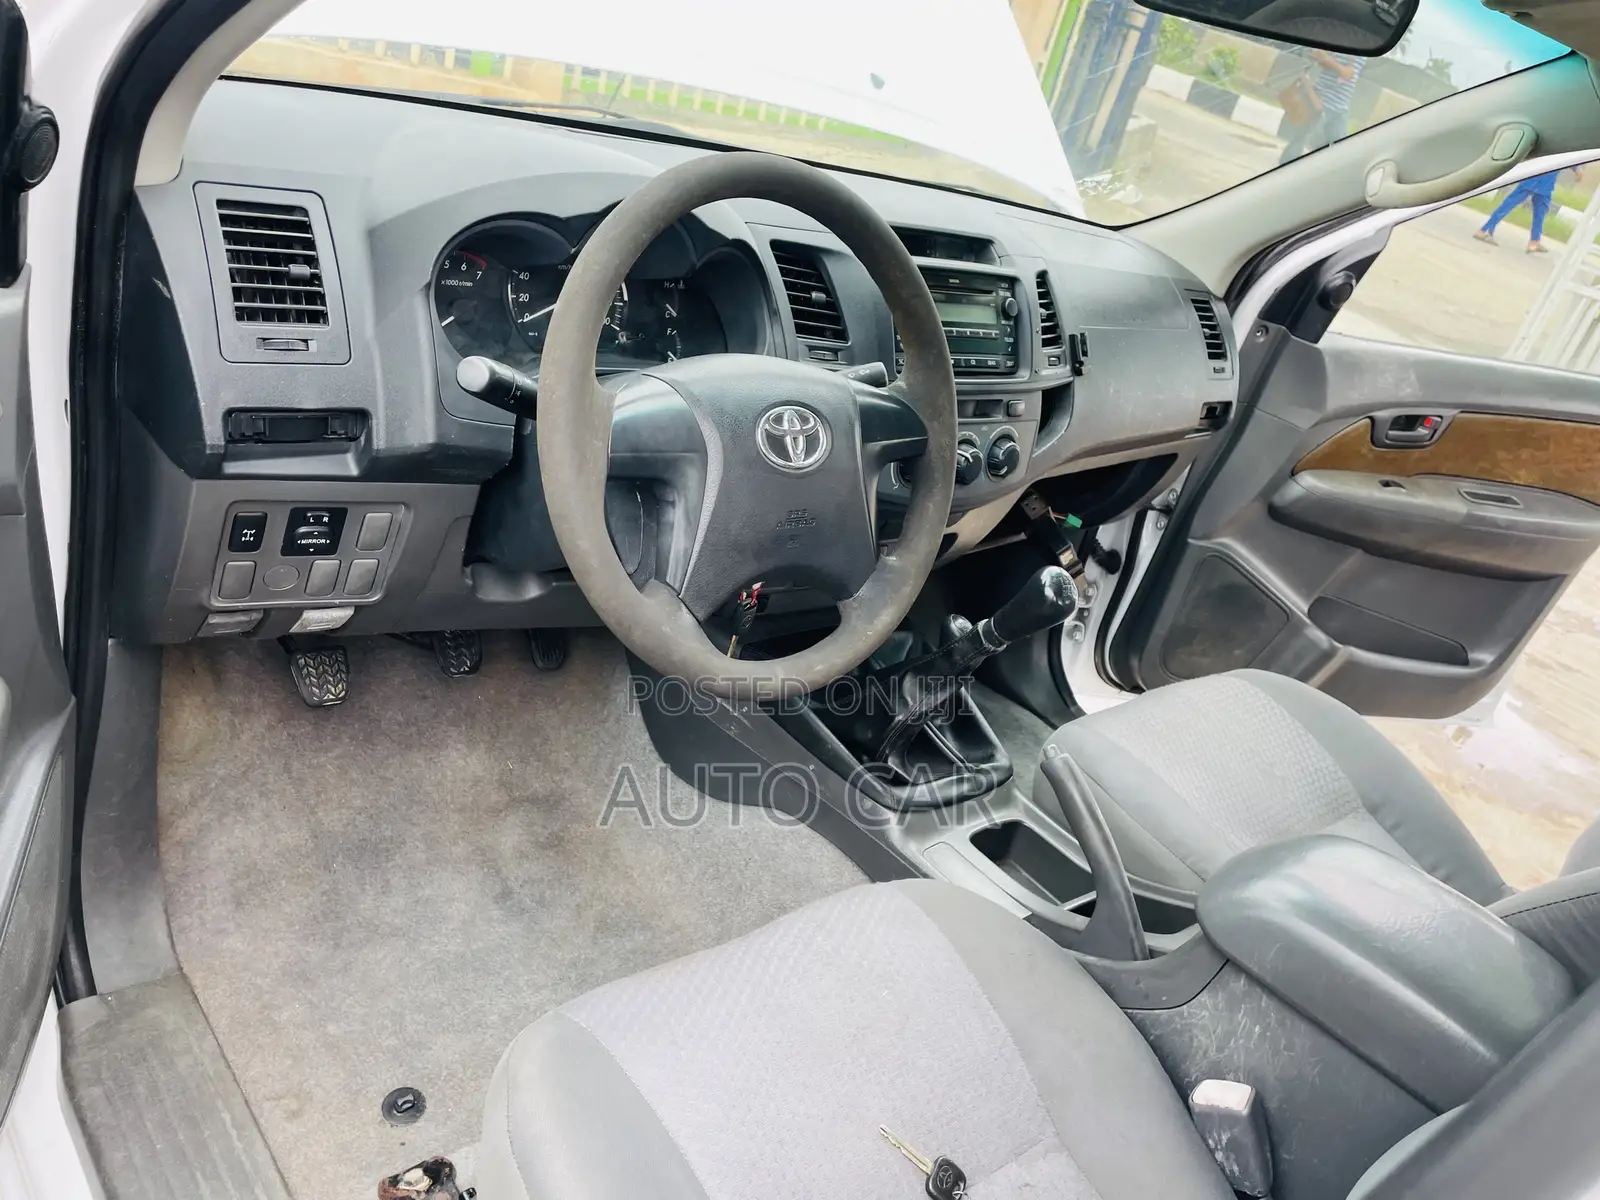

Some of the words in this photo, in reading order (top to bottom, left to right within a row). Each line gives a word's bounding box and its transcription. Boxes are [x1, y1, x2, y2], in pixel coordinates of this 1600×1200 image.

[443, 260, 450, 268] 5
[460, 262, 467, 270] 6
[476, 271, 482, 279] 7
[519, 272, 530, 280] 40
[518, 293, 530, 302] 20
